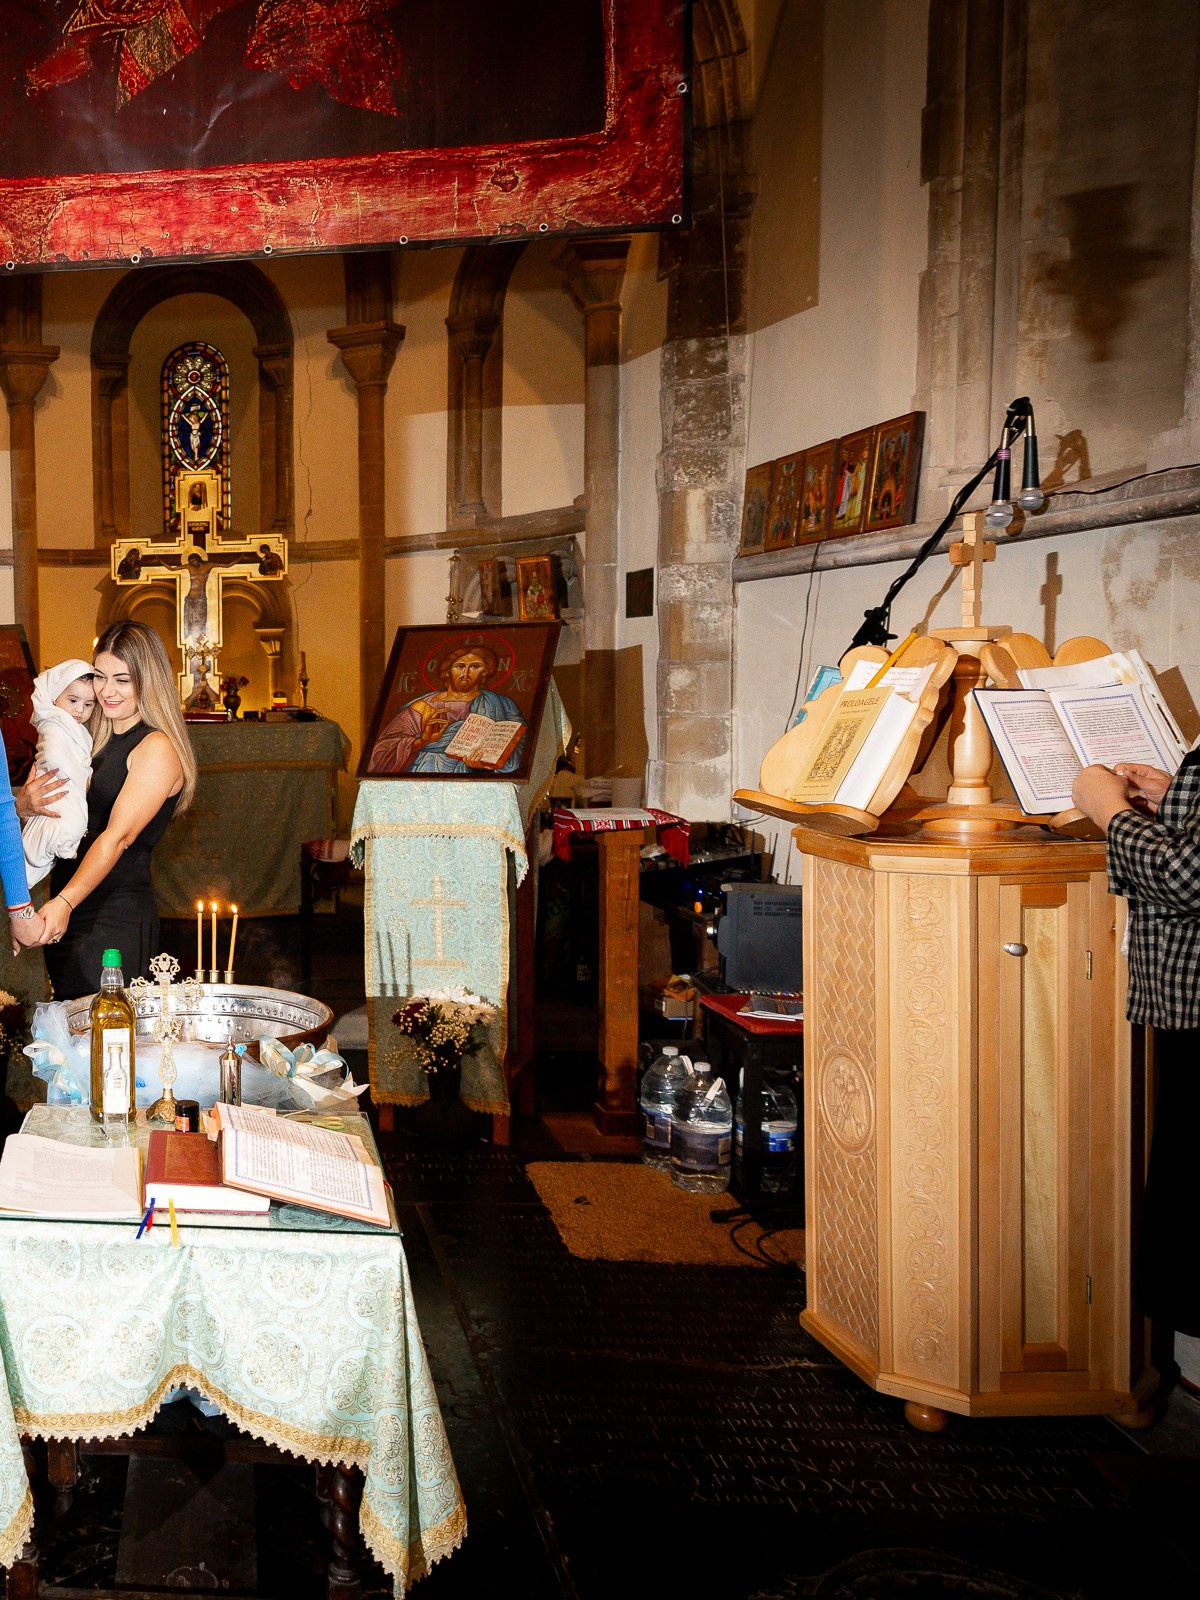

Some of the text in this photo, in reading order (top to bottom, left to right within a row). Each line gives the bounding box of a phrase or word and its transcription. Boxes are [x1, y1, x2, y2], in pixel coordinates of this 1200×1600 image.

[840, 697, 881, 709] PROLOAGELE
[704, 1453, 818, 1472] Norfolk
[828, 1458, 855, 1472] of
[873, 1453, 979, 1478] County
[710, 1472, 736, 1487] of
[751, 1474, 894, 1498] BACON
[689, 1486, 820, 1514] Memory
[910, 1481, 1094, 1508] EDMUND
[830, 1498, 874, 1515] the
